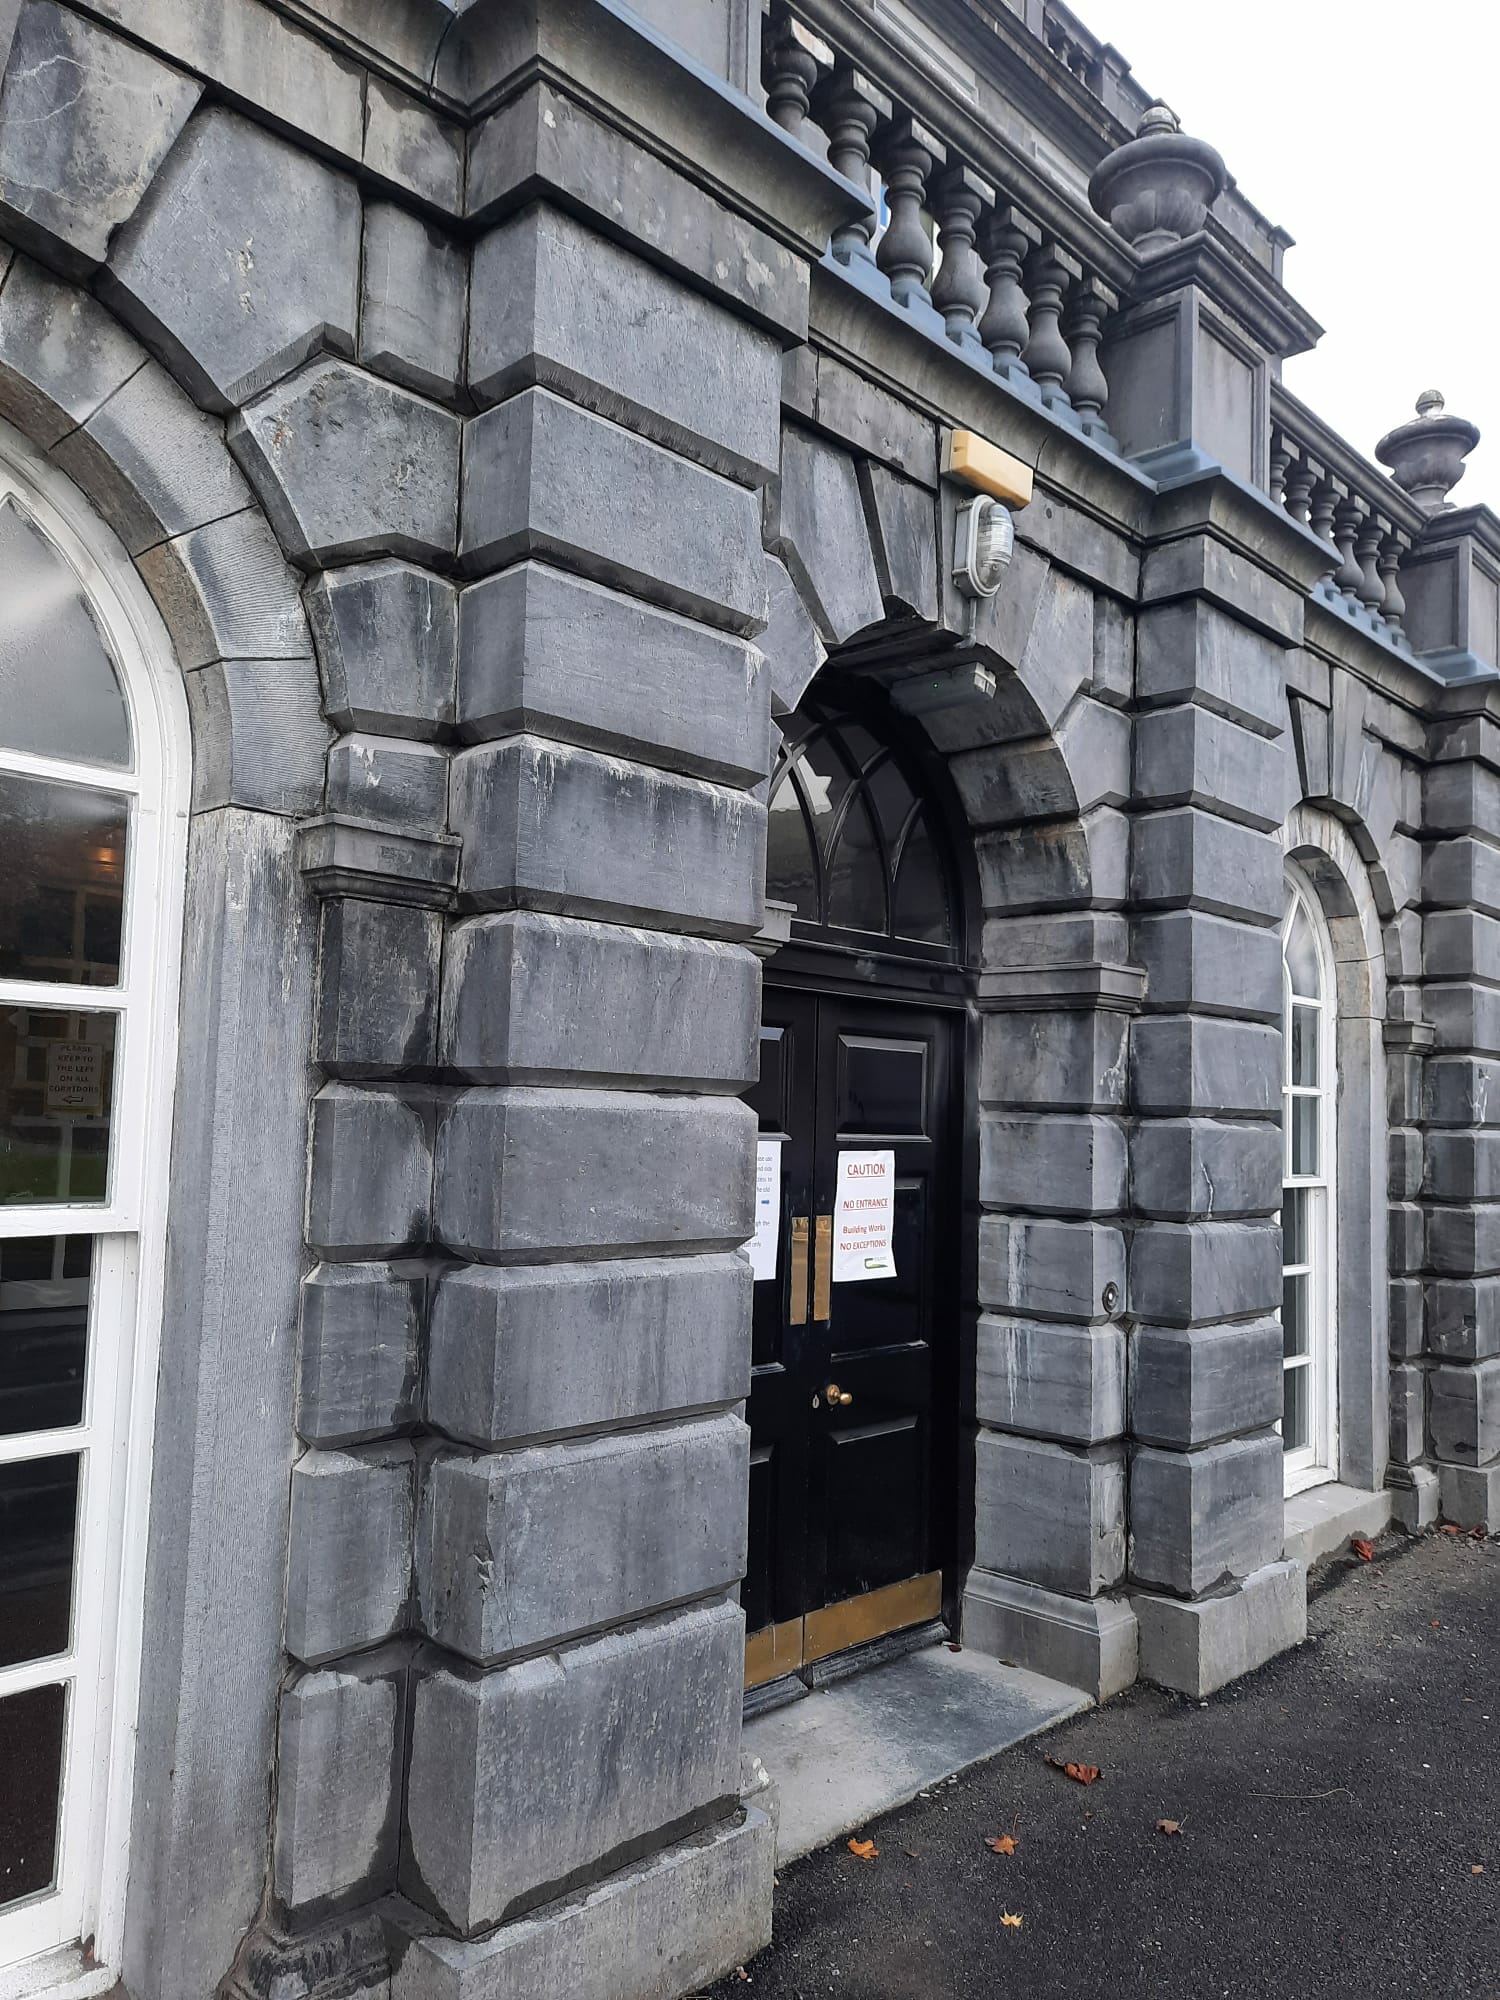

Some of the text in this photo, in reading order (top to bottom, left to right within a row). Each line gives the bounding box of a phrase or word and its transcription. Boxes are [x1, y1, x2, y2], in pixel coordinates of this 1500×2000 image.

[56, 1064, 94, 1073] THE LEFT
[847, 1163, 886, 1176] CAUTION
[843, 1198, 888, 1209] NO ENTRANCE
[843, 1224, 886, 1234] Building Works
[840, 1240, 887, 1250] NO EXCEPTIONS
